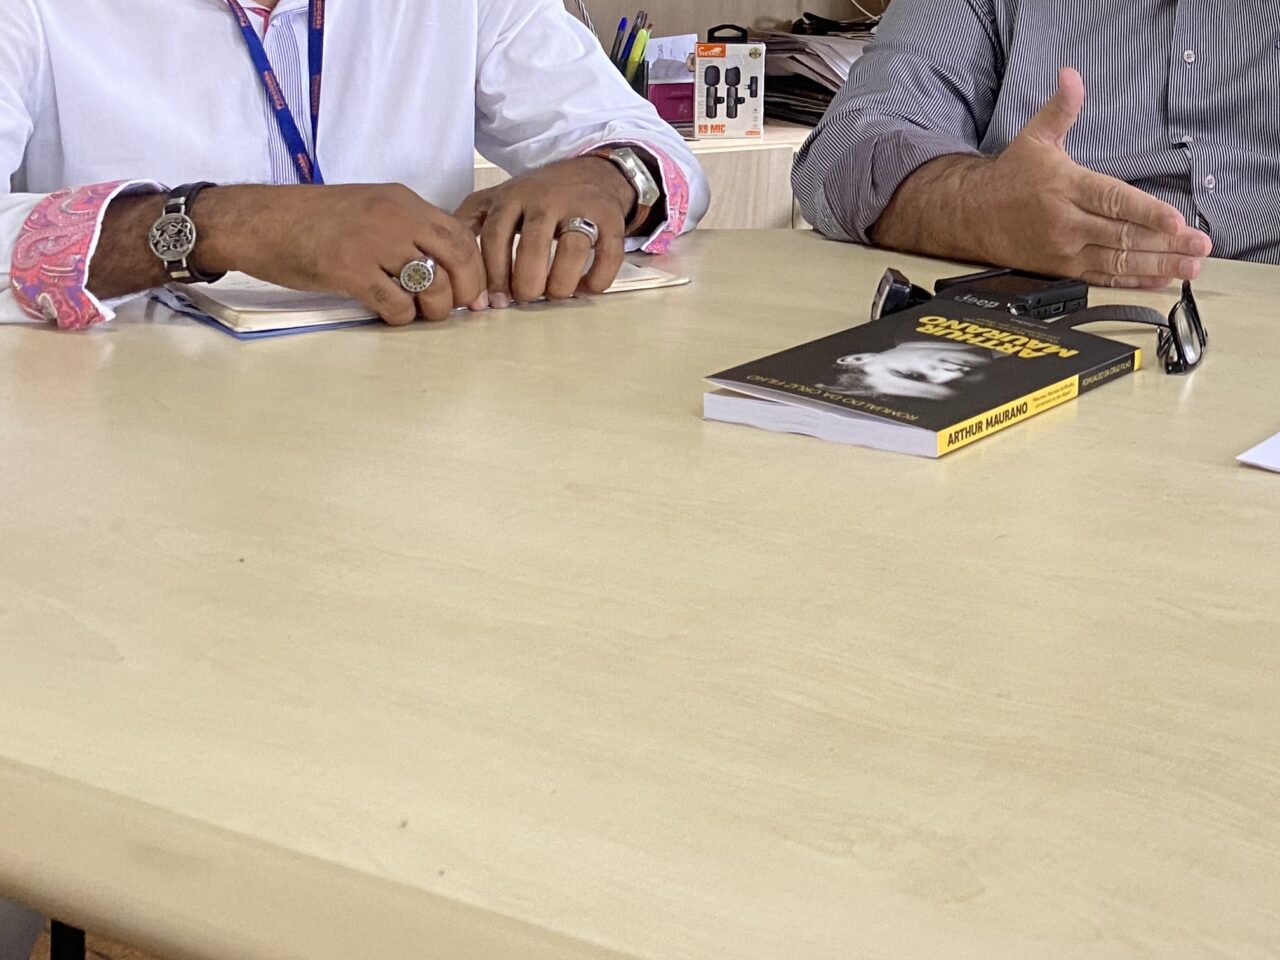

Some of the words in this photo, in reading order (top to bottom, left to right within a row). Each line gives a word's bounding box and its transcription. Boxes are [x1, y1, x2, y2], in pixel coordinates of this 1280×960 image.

[698, 125, 708, 133] K9
[710, 124, 726, 133] MIC
[953, 294, 1000, 308] Jeep
[916, 324, 1049, 358] ARTHUR
[919, 315, 1079, 358] MAURANO
[947, 419, 983, 448] ARTHUR
[985, 402, 1028, 430] MAURANO
